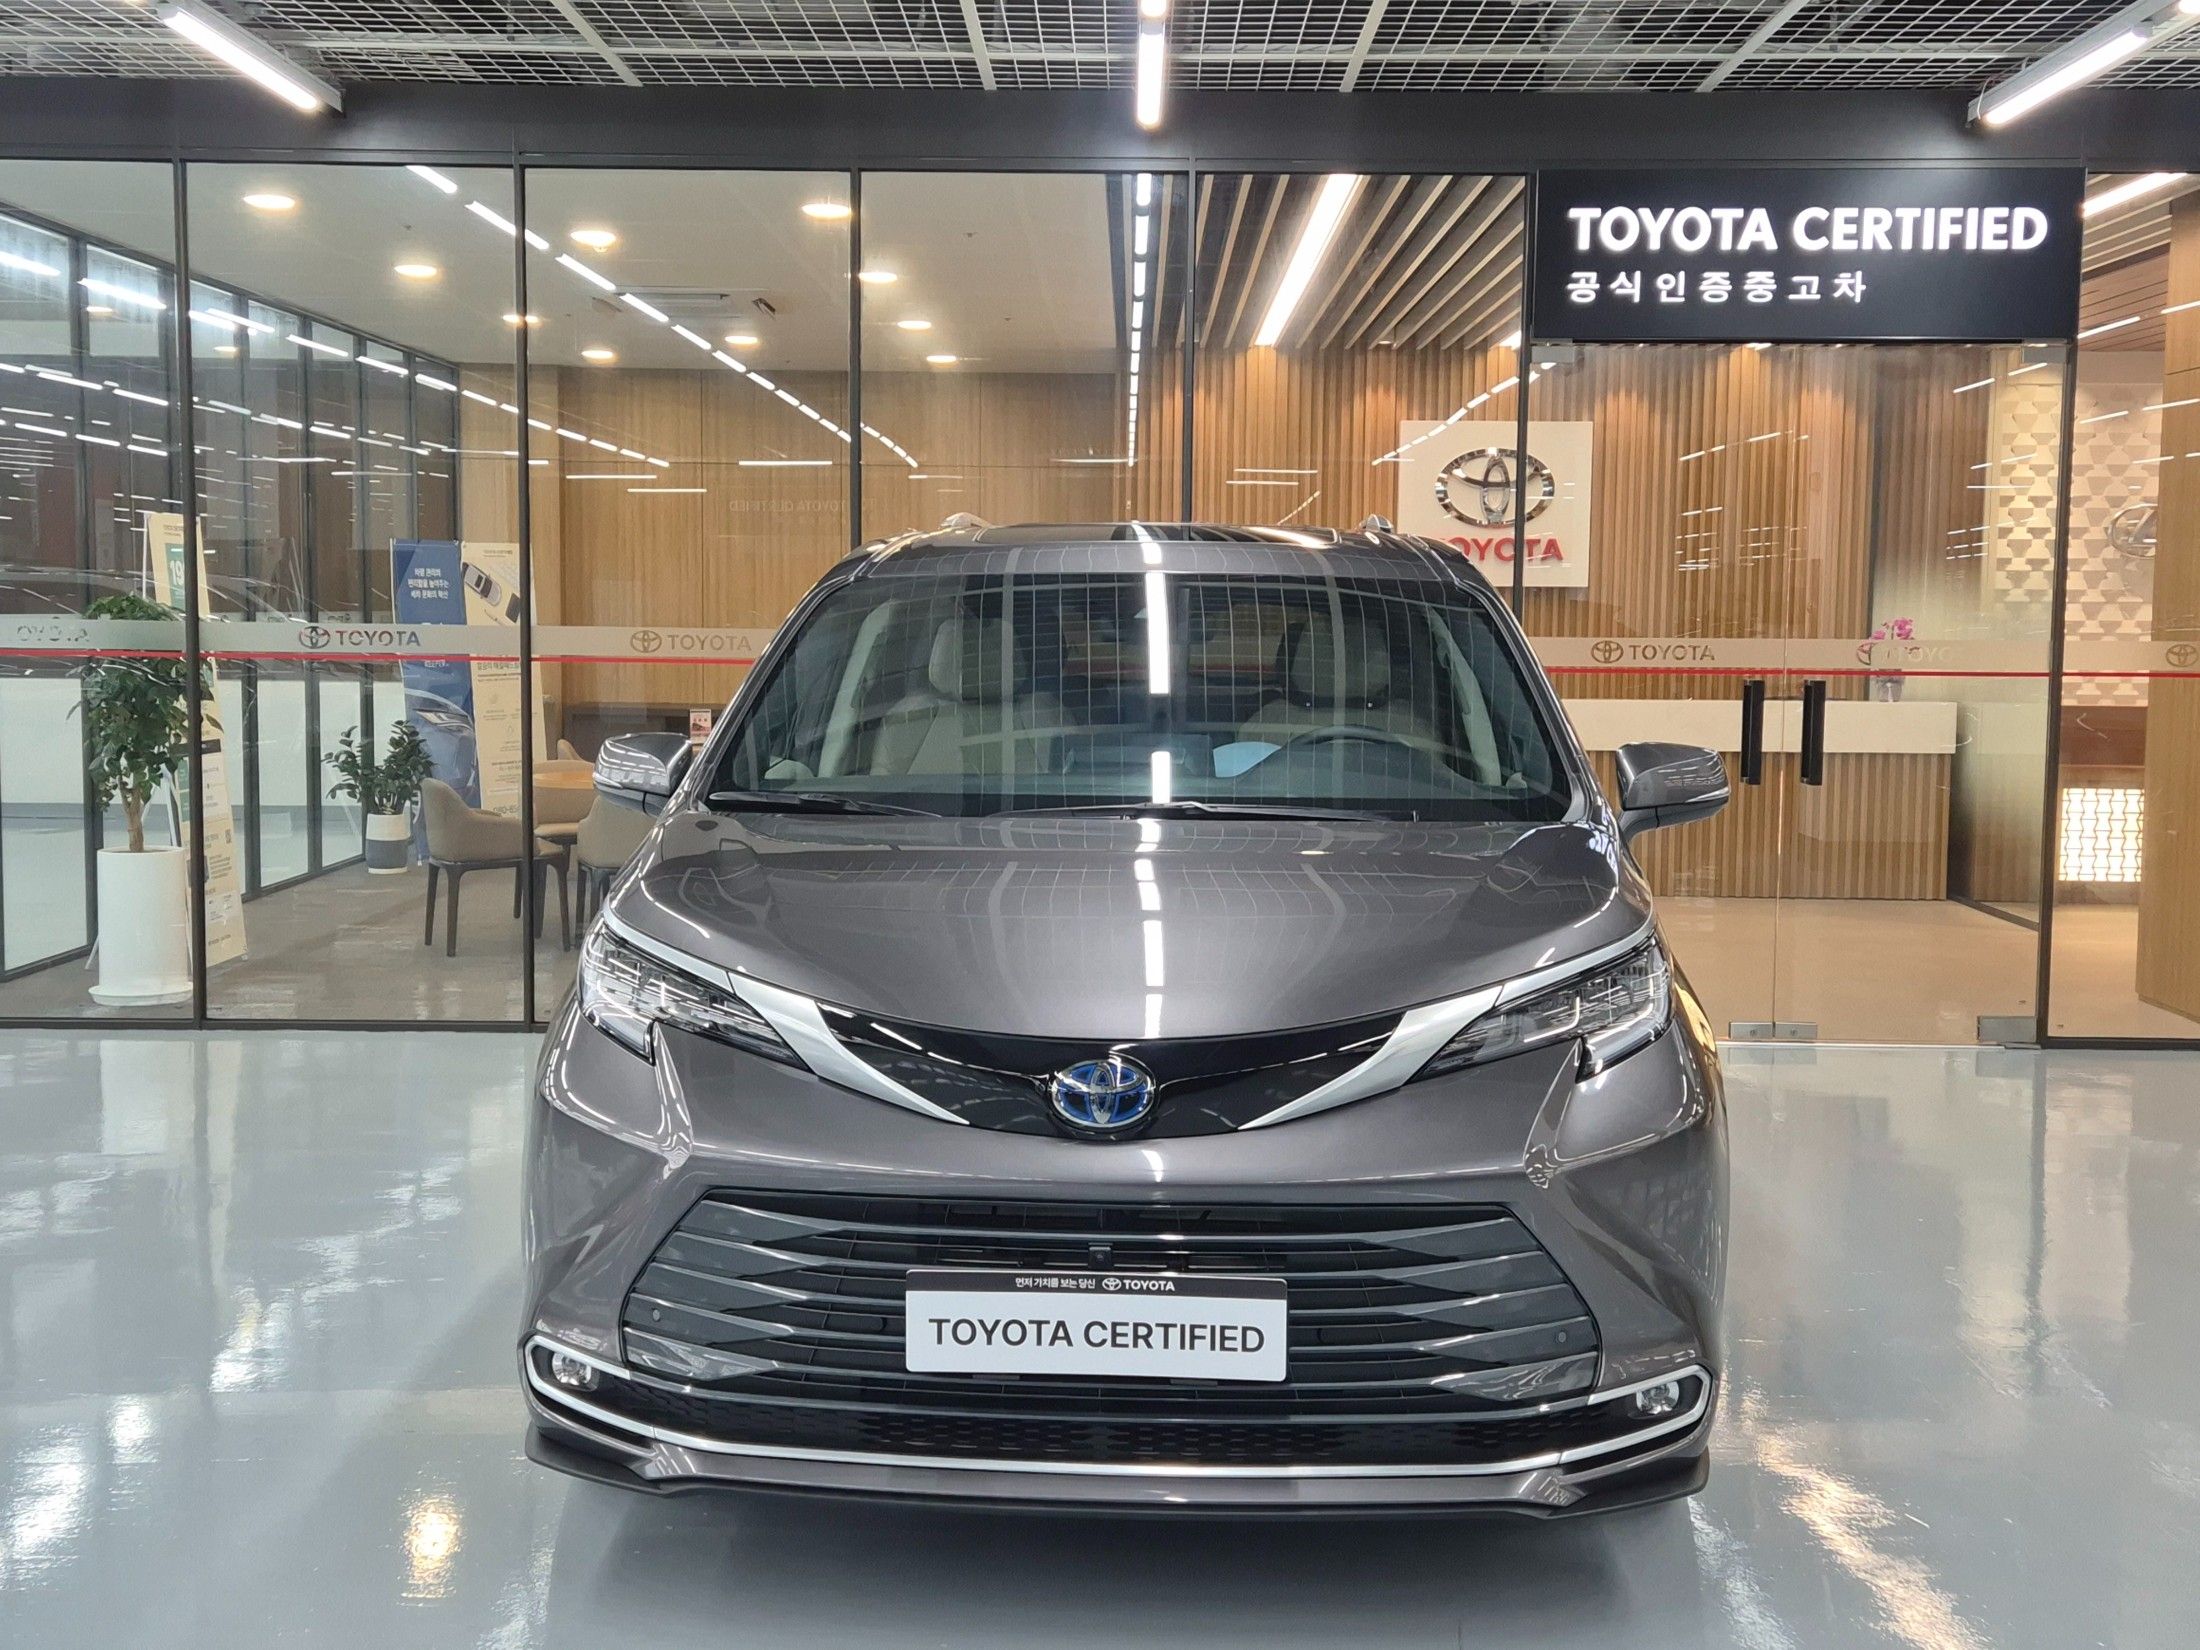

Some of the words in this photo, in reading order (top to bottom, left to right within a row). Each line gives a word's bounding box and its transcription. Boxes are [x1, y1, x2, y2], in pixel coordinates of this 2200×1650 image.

[1567, 205, 1779, 252] TOYOTA
[1792, 205, 2049, 252] CERTIFIED
[1440, 536, 1564, 562] OYOTA
[335, 630, 422, 647] TOYOTA
[667, 634, 752, 652] TOYOTA
[1628, 644, 1716, 662] TOYOTA
[1015, 1277, 1033, 1288] 먼저
[1033, 1277, 1059, 1288] 가치를
[1060, 1278, 1077, 1288] 보는
[1078, 1278, 1096, 1289] 당신
[1123, 1279, 1175, 1292] TOYOTA
[928, 1317, 1074, 1348] TOYOTA
[1083, 1320, 1265, 1354] CERTIFIED
